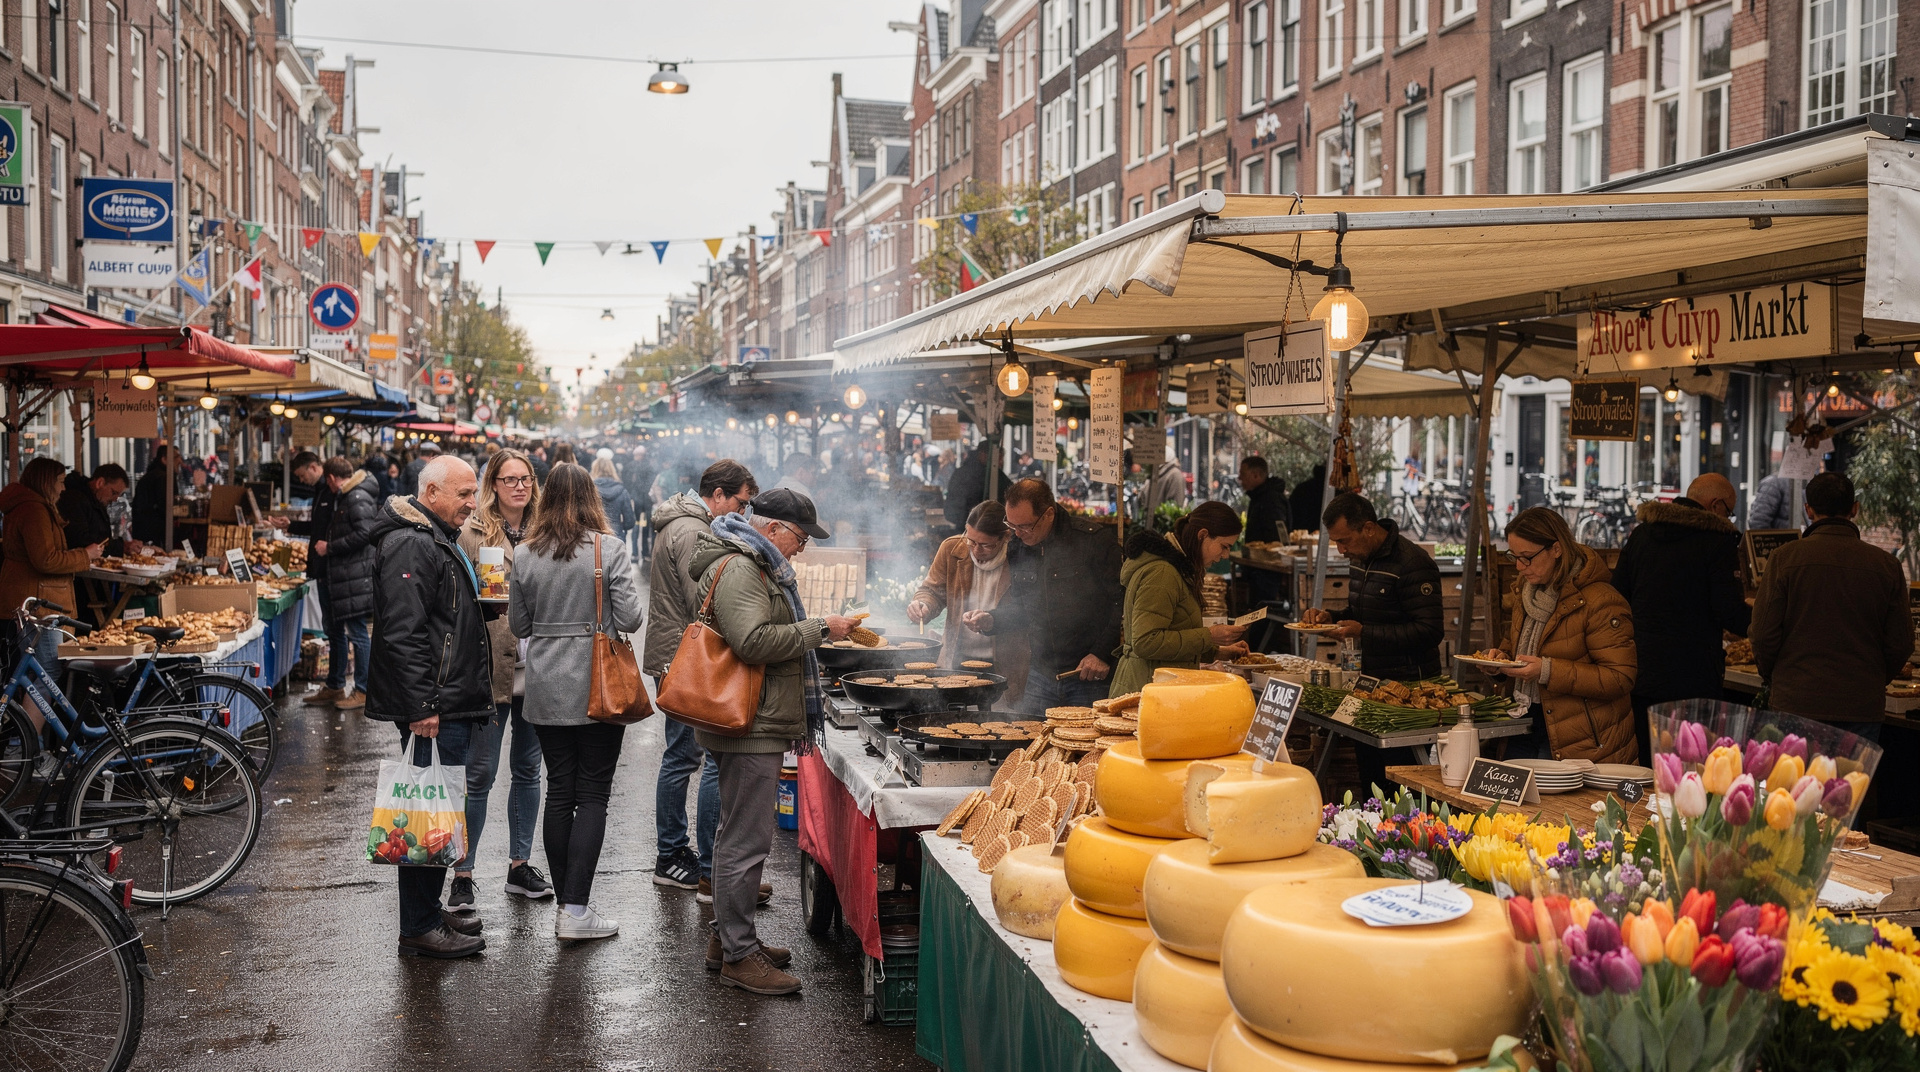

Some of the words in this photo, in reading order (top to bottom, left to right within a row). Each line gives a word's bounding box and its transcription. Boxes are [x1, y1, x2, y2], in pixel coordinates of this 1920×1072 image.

[88, 260, 134, 273] ALBERT
[1589, 308, 1656, 356] Albert
[1661, 300, 1720, 358] Cuyp
[1250, 357, 1322, 387] STROOPWAFELS
[1573, 398, 1633, 427] Stroopwafels
